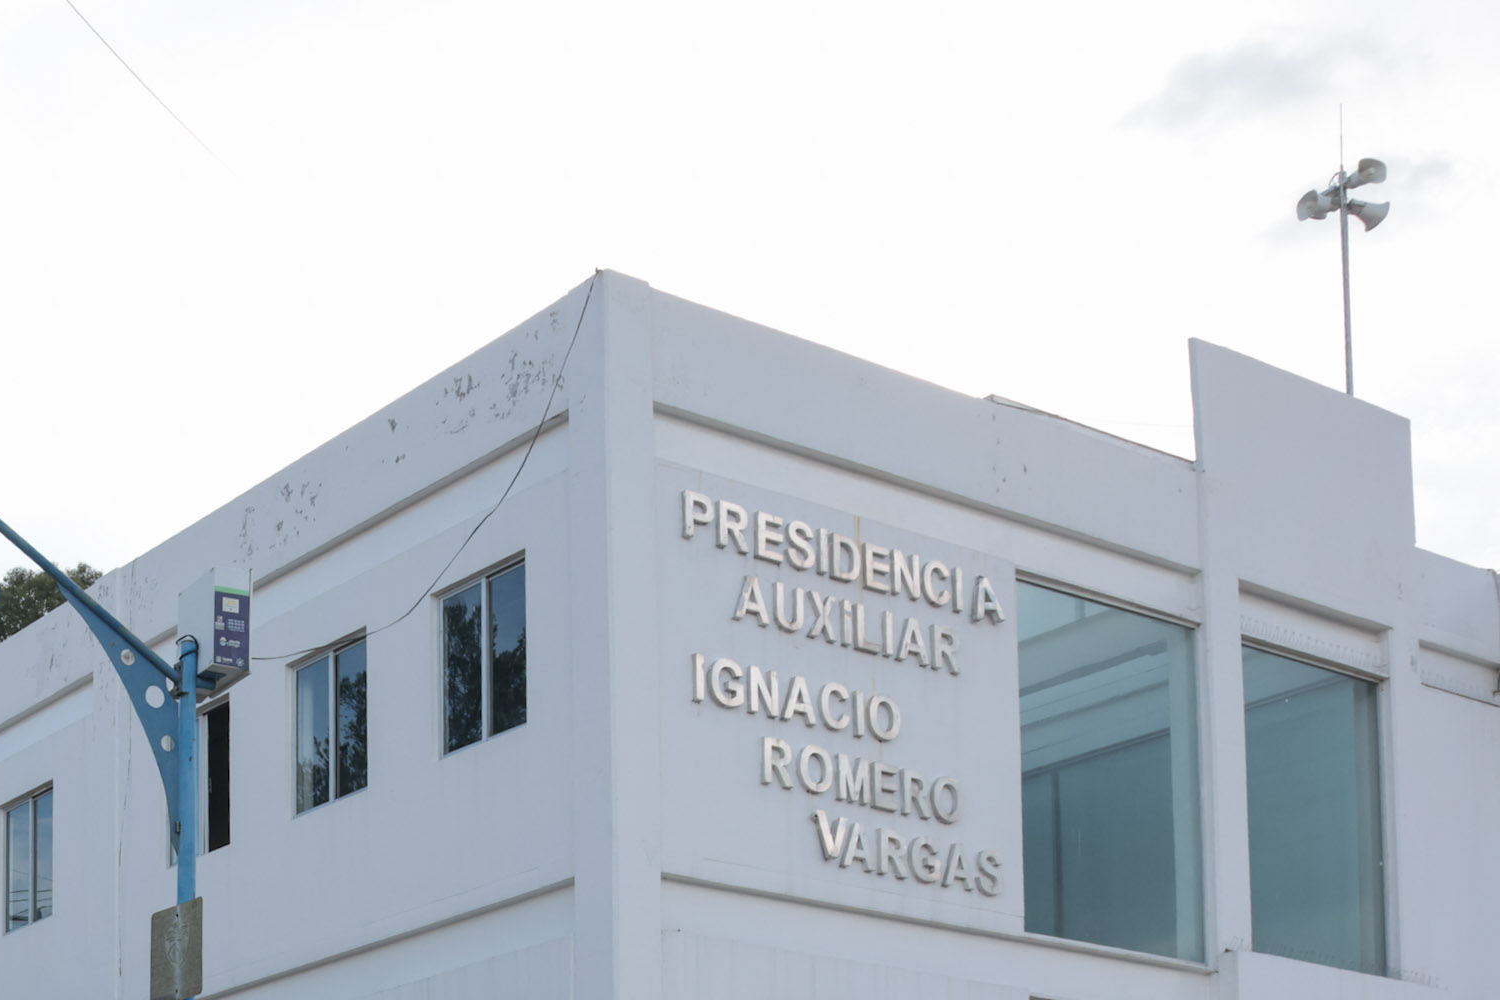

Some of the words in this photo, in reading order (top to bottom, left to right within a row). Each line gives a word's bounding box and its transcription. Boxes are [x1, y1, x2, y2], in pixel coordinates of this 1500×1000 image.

[681, 489, 1006, 624] PRESIDENCIA
[691, 653, 902, 742] IGNACIO
[761, 736, 963, 824] ROMERO
[812, 810, 1003, 897] VARGAS
